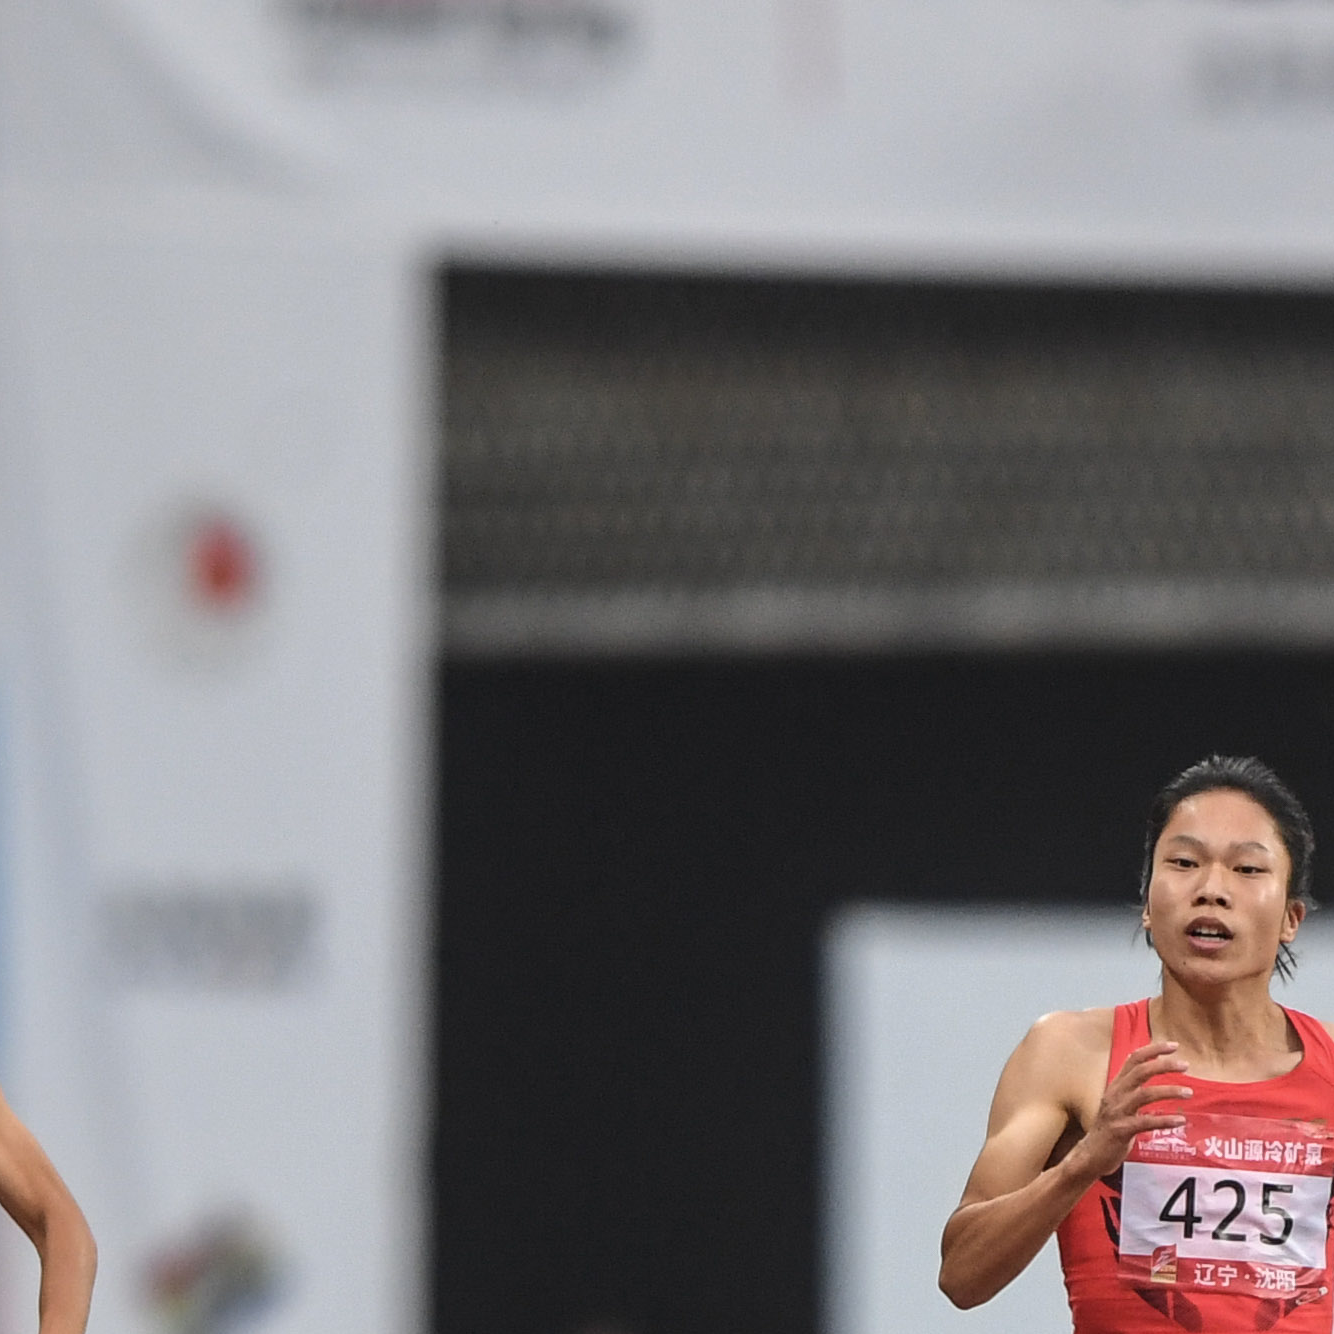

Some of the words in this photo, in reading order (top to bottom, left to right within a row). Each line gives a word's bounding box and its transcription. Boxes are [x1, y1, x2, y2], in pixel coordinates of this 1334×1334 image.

[1204, 1136, 1323, 1165] 火山源冷矿泉
[1159, 1177, 1293, 1245] 425
[1194, 1263, 1296, 1290] 辽宁·沈阳
